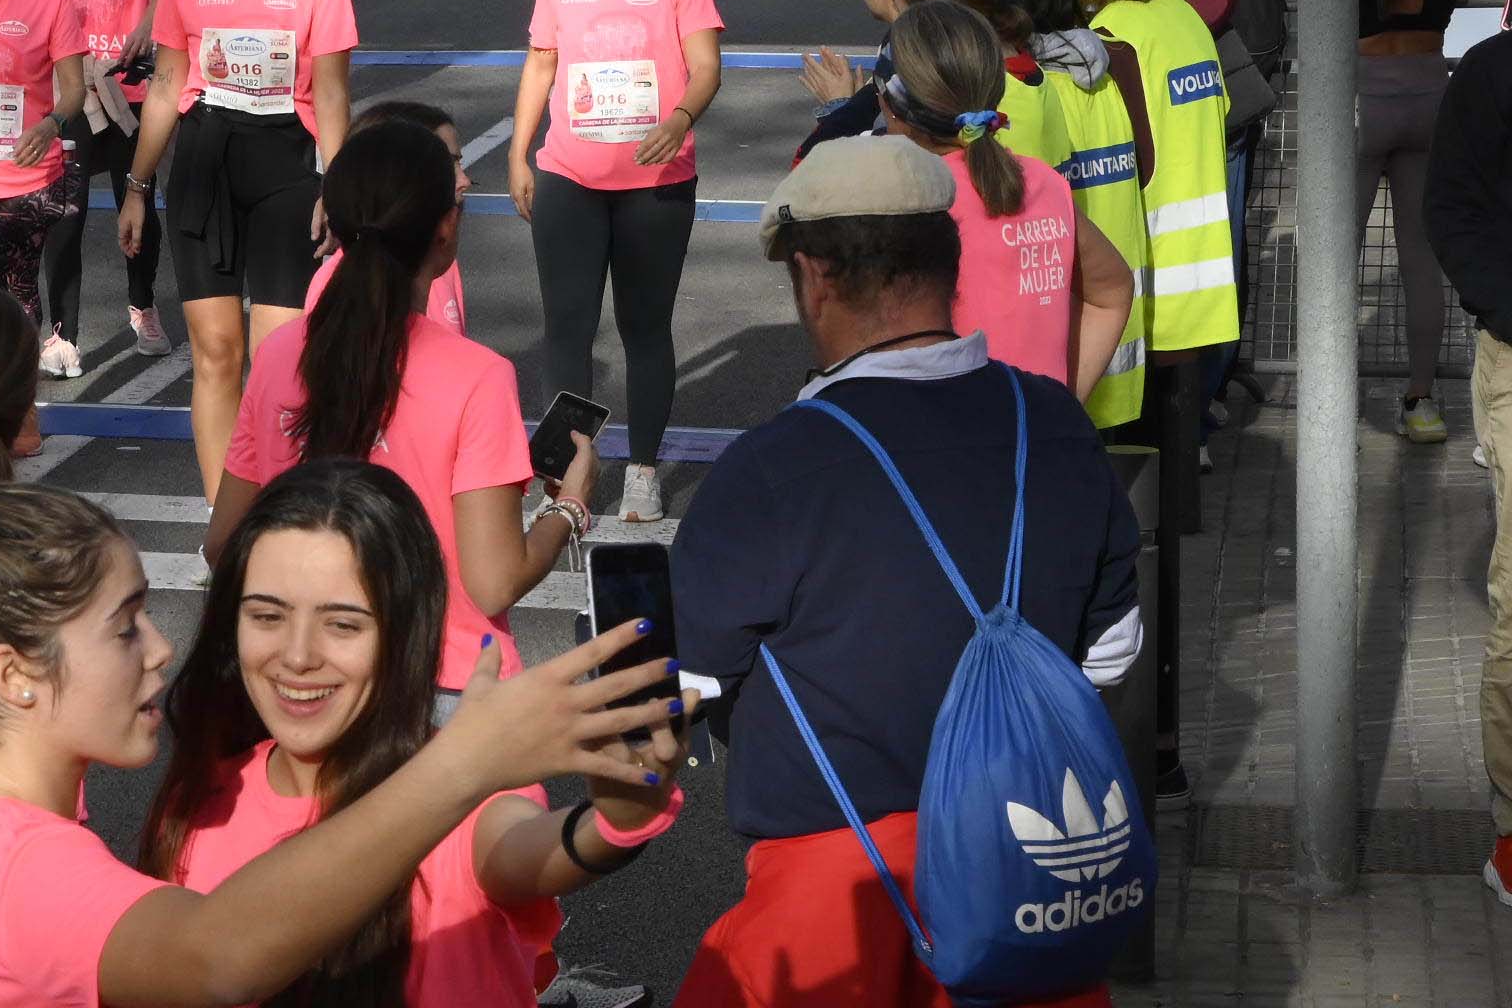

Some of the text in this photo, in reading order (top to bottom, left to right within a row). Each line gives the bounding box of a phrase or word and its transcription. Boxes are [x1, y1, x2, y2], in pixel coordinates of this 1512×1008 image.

[231, 63, 262, 75] 016
[597, 93, 627, 105] 016
[1001, 216, 1070, 247] CARRERA
[1020, 242, 1061, 270] DE LA
[1019, 267, 1065, 296] MUJER
[1039, 296, 1051, 305] 2023
[1015, 878, 1143, 934] adidas
